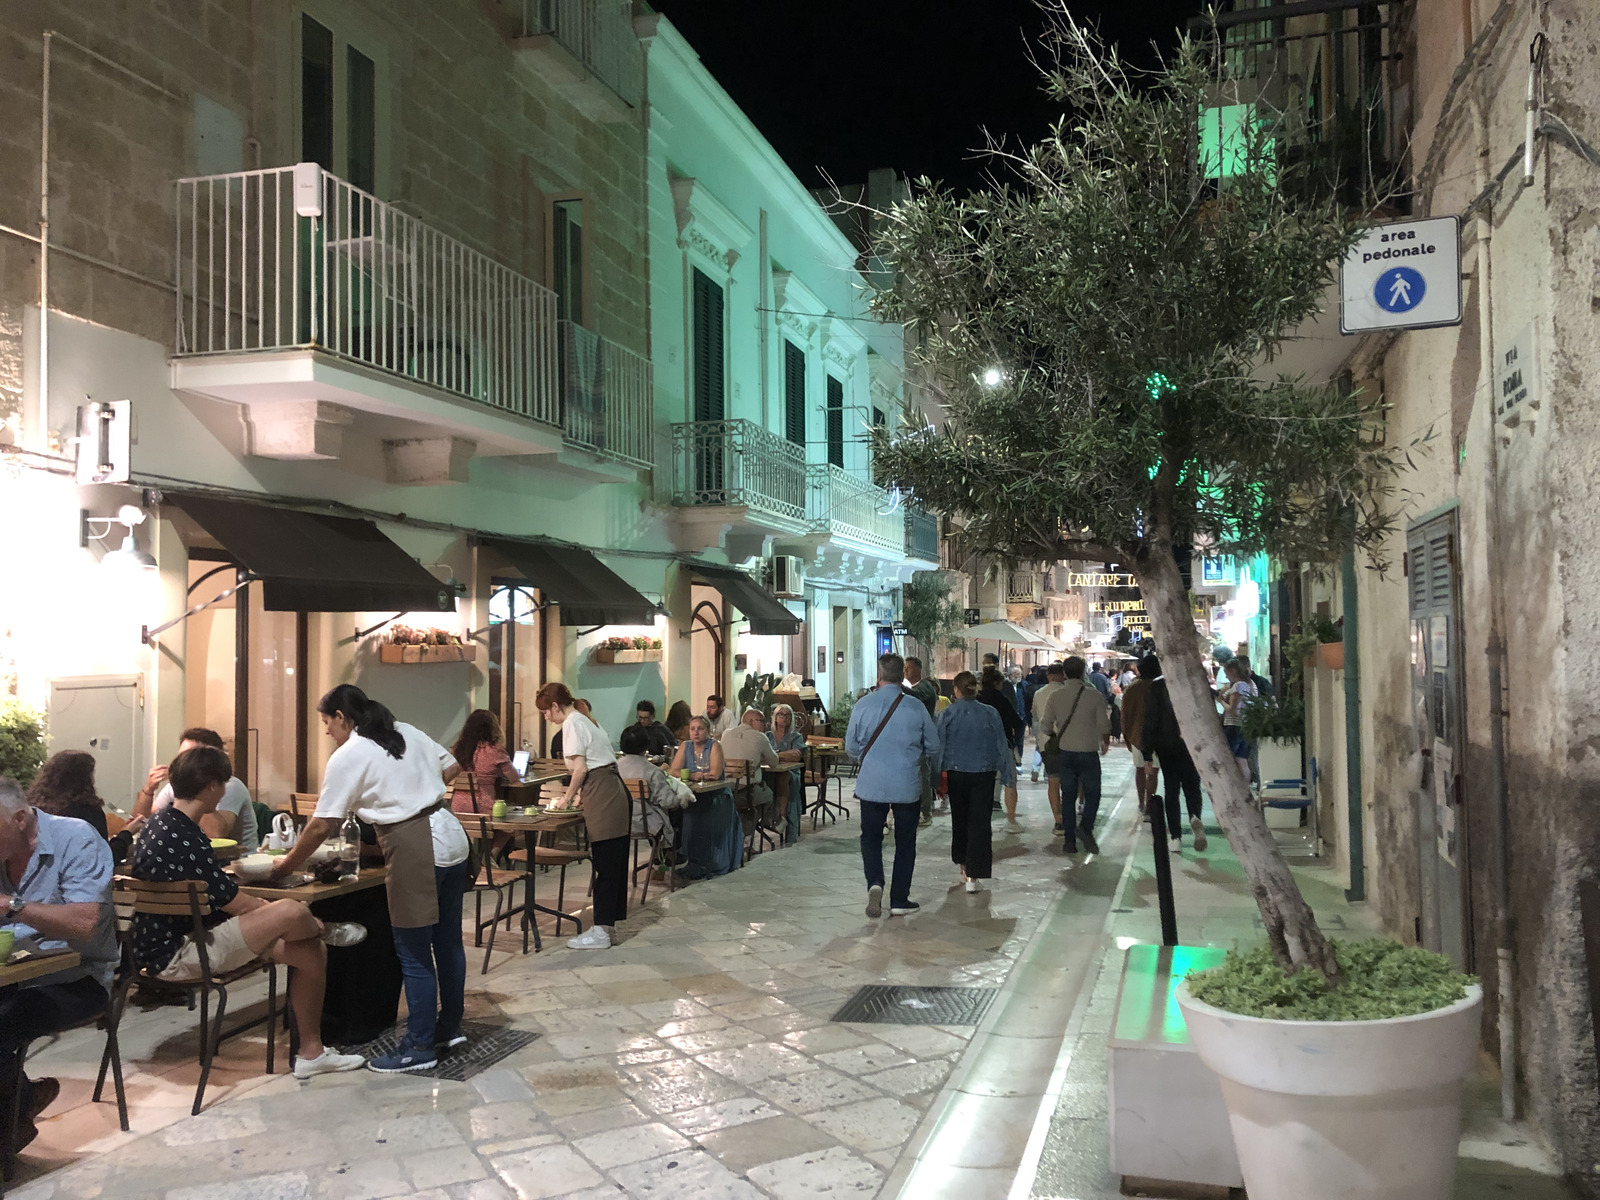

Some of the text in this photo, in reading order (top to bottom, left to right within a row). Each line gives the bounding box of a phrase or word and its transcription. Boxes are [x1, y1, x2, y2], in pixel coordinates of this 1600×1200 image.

[1381, 229, 1416, 243] area
[1363, 243, 1436, 263] pedonale
[1505, 345, 1518, 366] VIA
